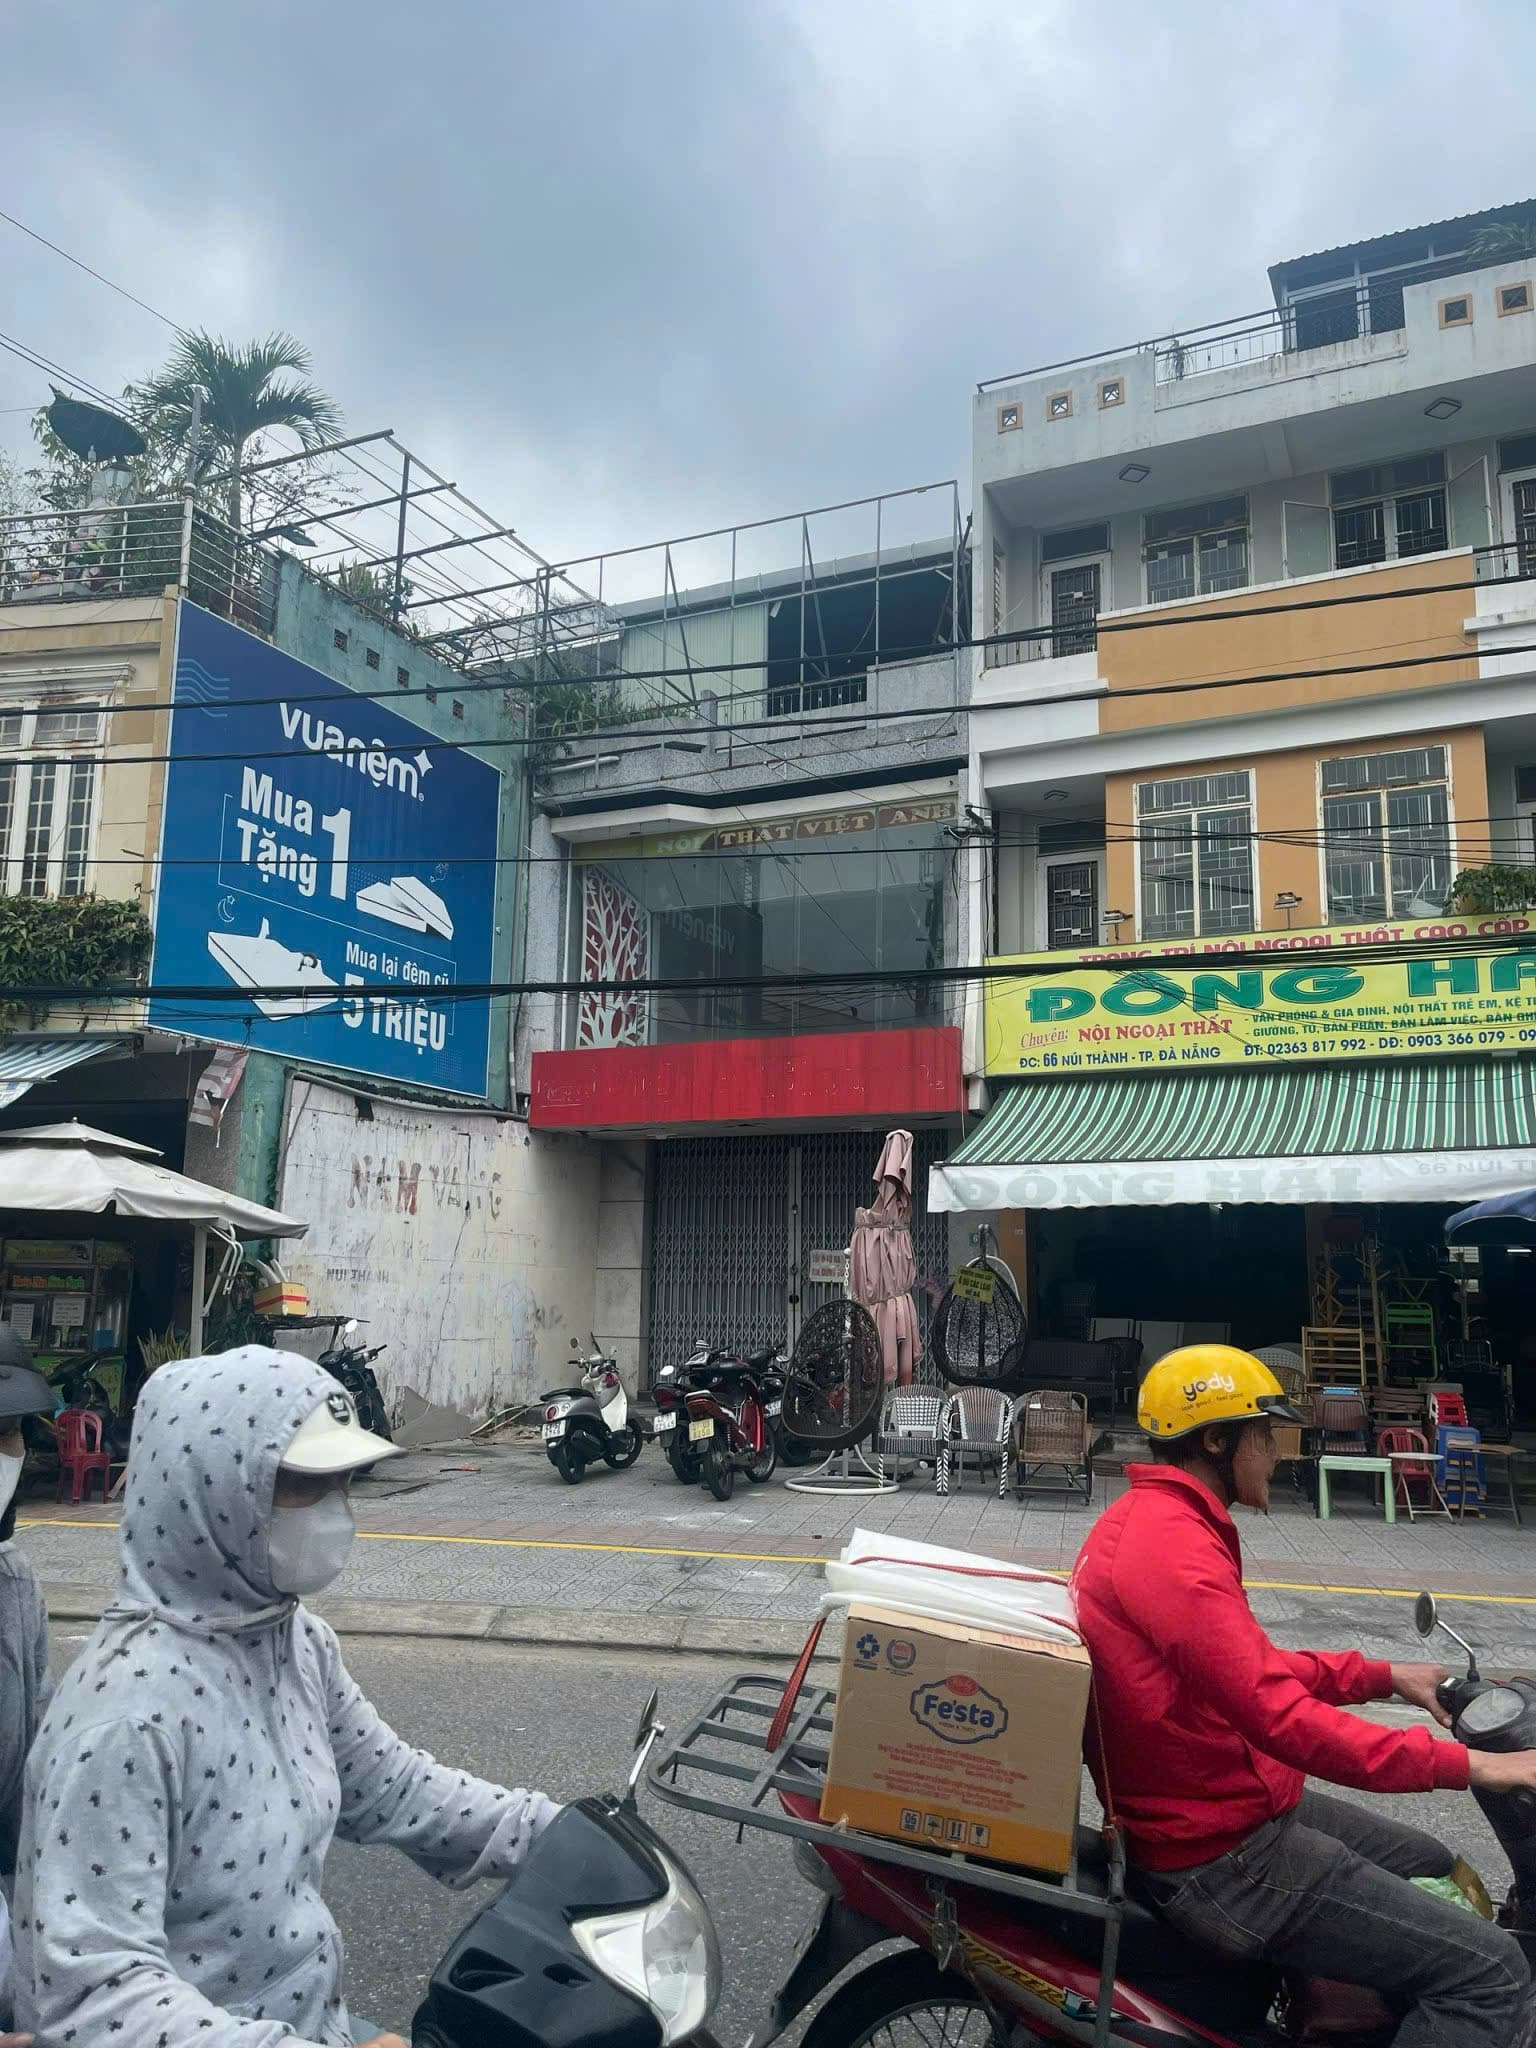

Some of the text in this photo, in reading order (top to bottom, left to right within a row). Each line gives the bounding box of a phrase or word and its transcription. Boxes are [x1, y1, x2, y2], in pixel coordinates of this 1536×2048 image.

[241, 766, 313, 835] Mua
[803, 815, 869, 835] VIỆT
[889, 803, 951, 825] ANH
[236, 818, 318, 898] Tặng
[321, 806, 351, 901] 1
[1414, 923, 1468, 940] CAO
[346, 941, 377, 971] Mua
[382, 952, 398, 981] lại
[1026, 966, 1365, 1024] ĐÔNG
[368, 998, 446, 1056] TRIỆU
[1078, 1023, 1111, 1045] NỘI
[1116, 1022, 1175, 1042] NGOẠI
[1180, 1013, 1233, 1036] THẤT
[1321, 1009, 1329, 1019] &
[1333, 1008, 1354, 1018] GIA
[1019, 1057, 1041, 1068] ĐC:
[1043, 1053, 1058, 1067] 66
[1062, 1051, 1082, 1066] NÚI
[1085, 1049, 1128, 1065] THÀNH
[1138, 1050, 1155, 1062] TP.
[1159, 1046, 1177, 1061] ĐÀ
[1181, 1042, 1221, 1059] NẴNG
[1244, 1044, 1264, 1056] ĐT:
[1267, 1041, 1308, 1055] 02363
[1312, 1040, 1336, 1053] 817
[1340, 1038, 1366, 1050] 992
[1379, 1036, 1404, 1048] DĐ:
[1407, 1034, 1442, 1048] 0903
[1447, 1033, 1474, 1045] 366
[1479, 1030, 1505, 1044] 079
[1418, 1162, 1447, 1176] 66
[1182, 1372, 1235, 1402] yody
